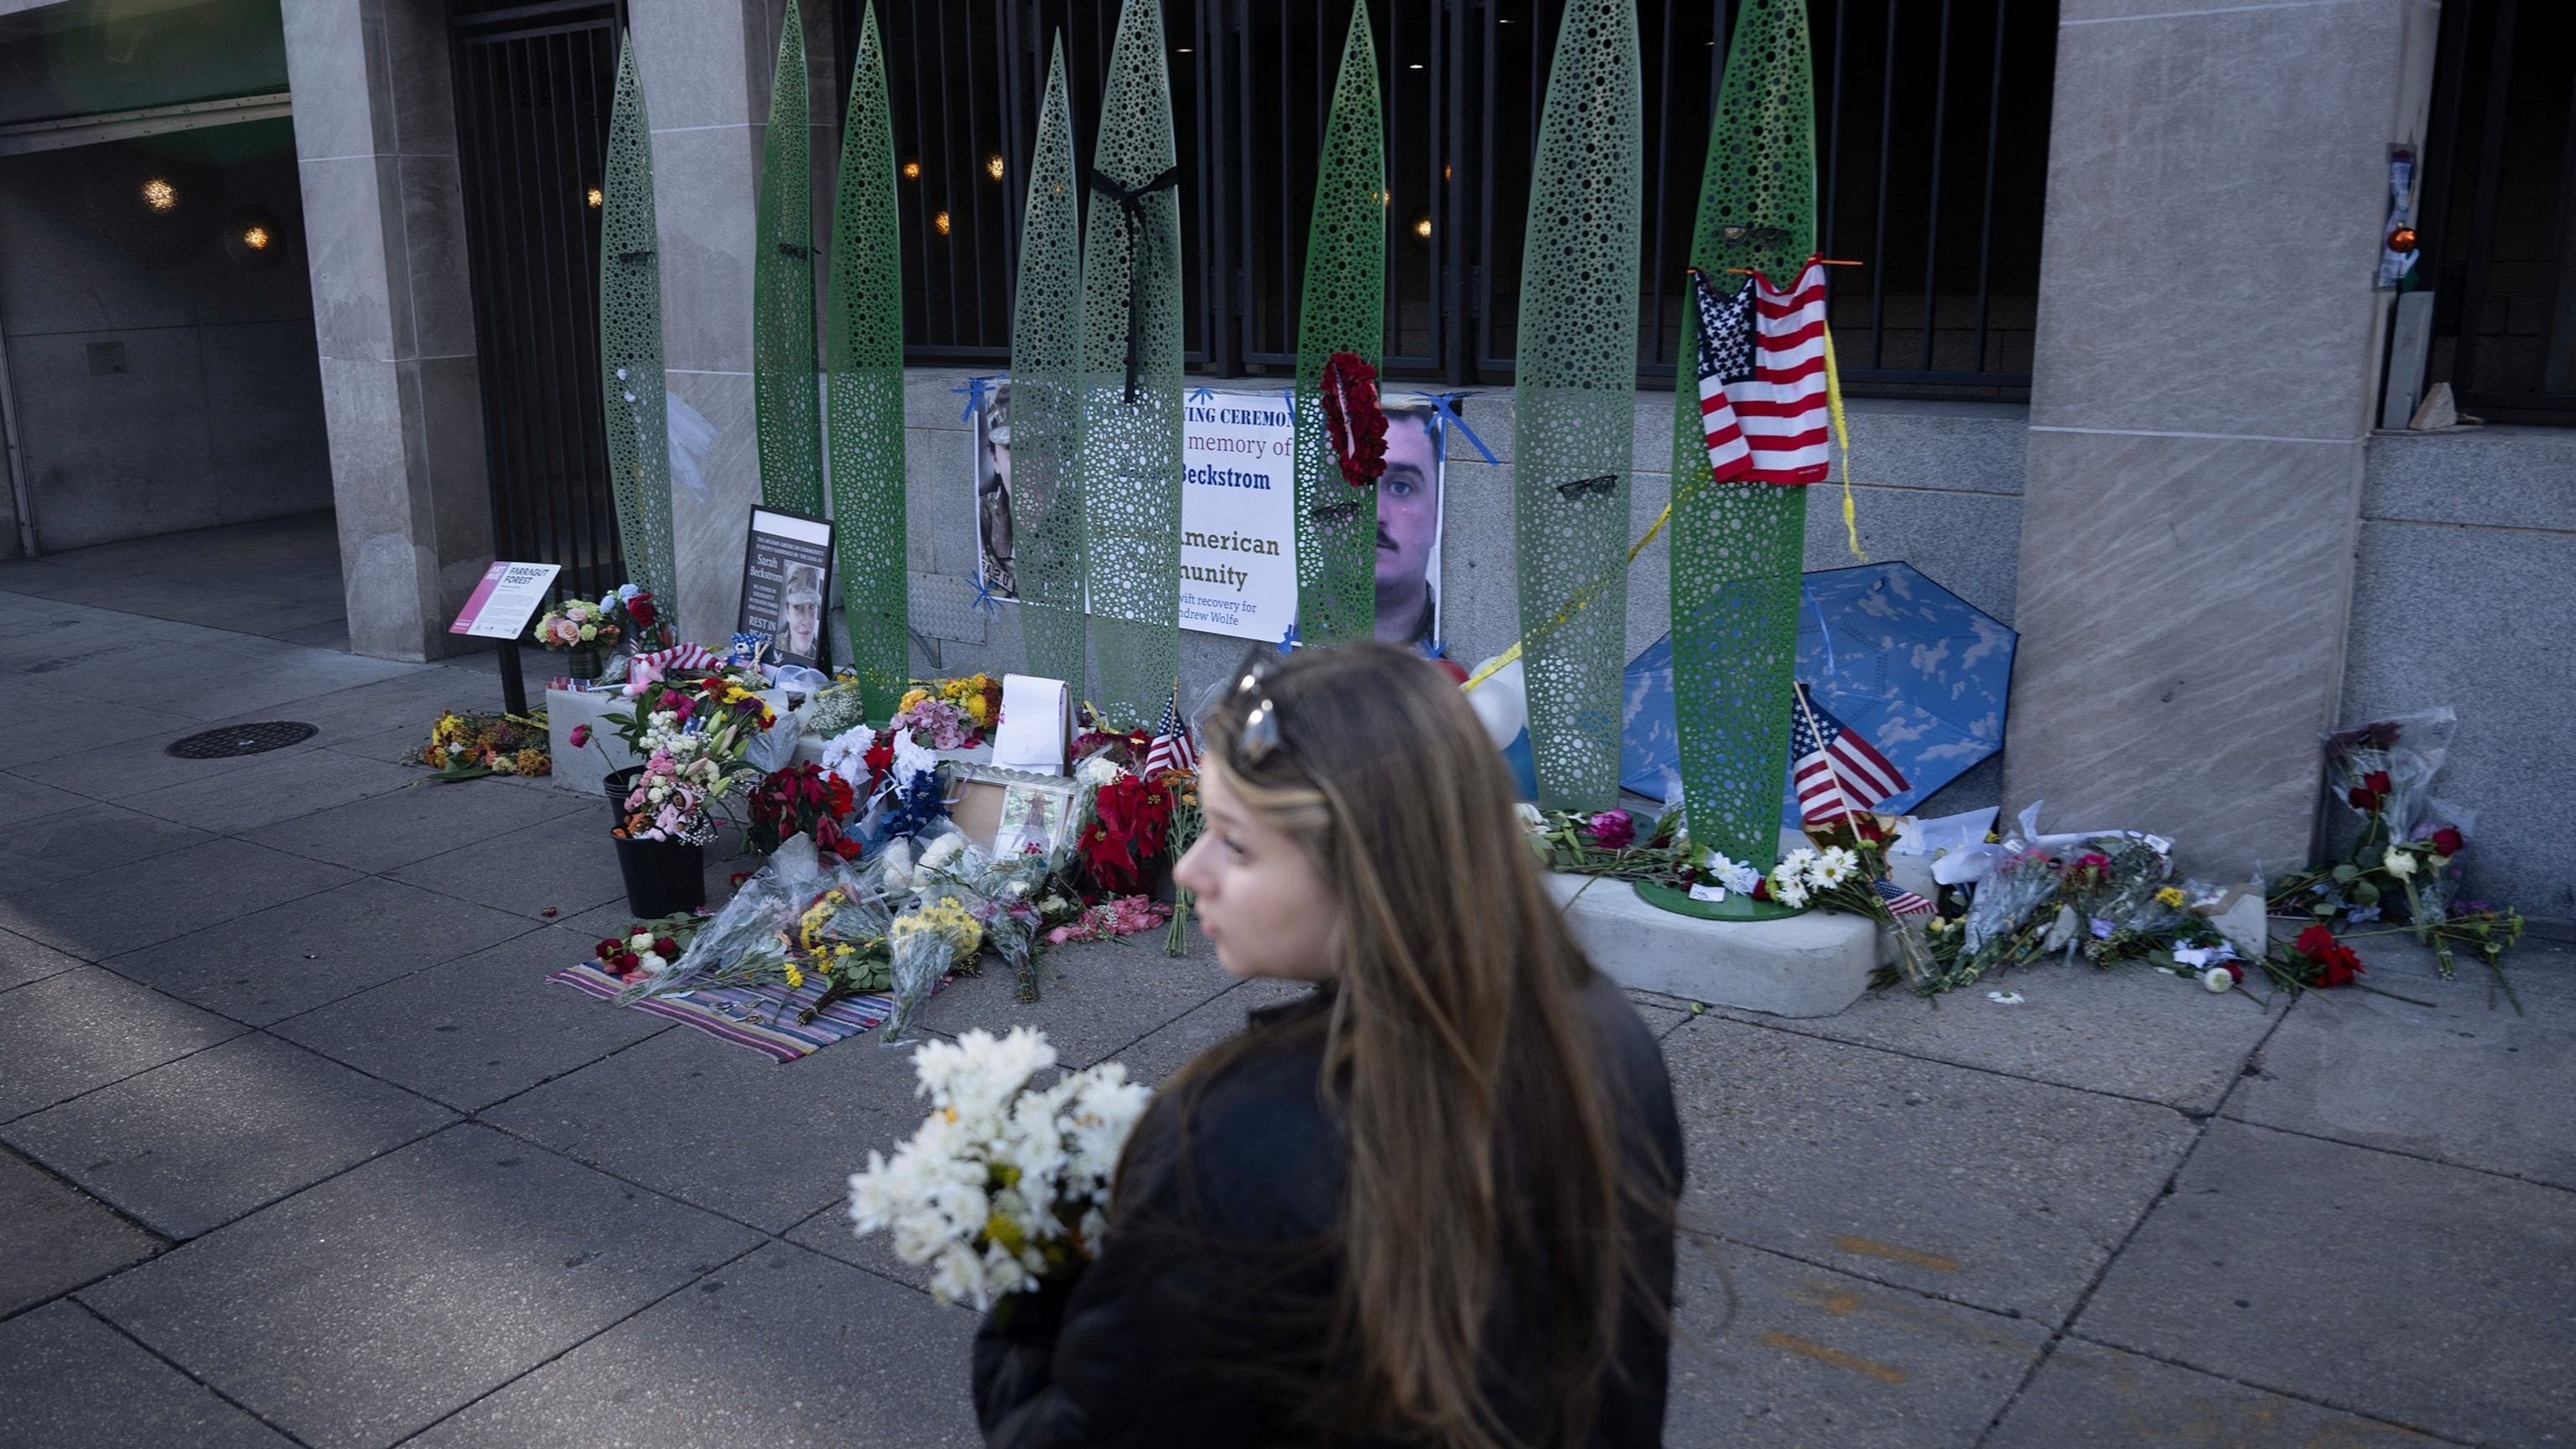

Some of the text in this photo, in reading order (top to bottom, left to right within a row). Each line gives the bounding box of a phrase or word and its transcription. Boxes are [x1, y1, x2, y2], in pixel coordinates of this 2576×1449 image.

[1188, 435, 1266, 460] memory
[1273, 437, 1293, 456] of
[1181, 531, 1280, 556] merican
[756, 553, 778, 569] Sarah
[503, 575, 533, 584] FOREST
[509, 567, 550, 577] FARRAGUT
[750, 565, 783, 583] Beckstrom
[1197, 597, 1240, 613] recovery
[1242, 600, 1257, 613] for
[749, 615, 776, 631] REST IN
[1210, 611, 1239, 626] Wolfe
